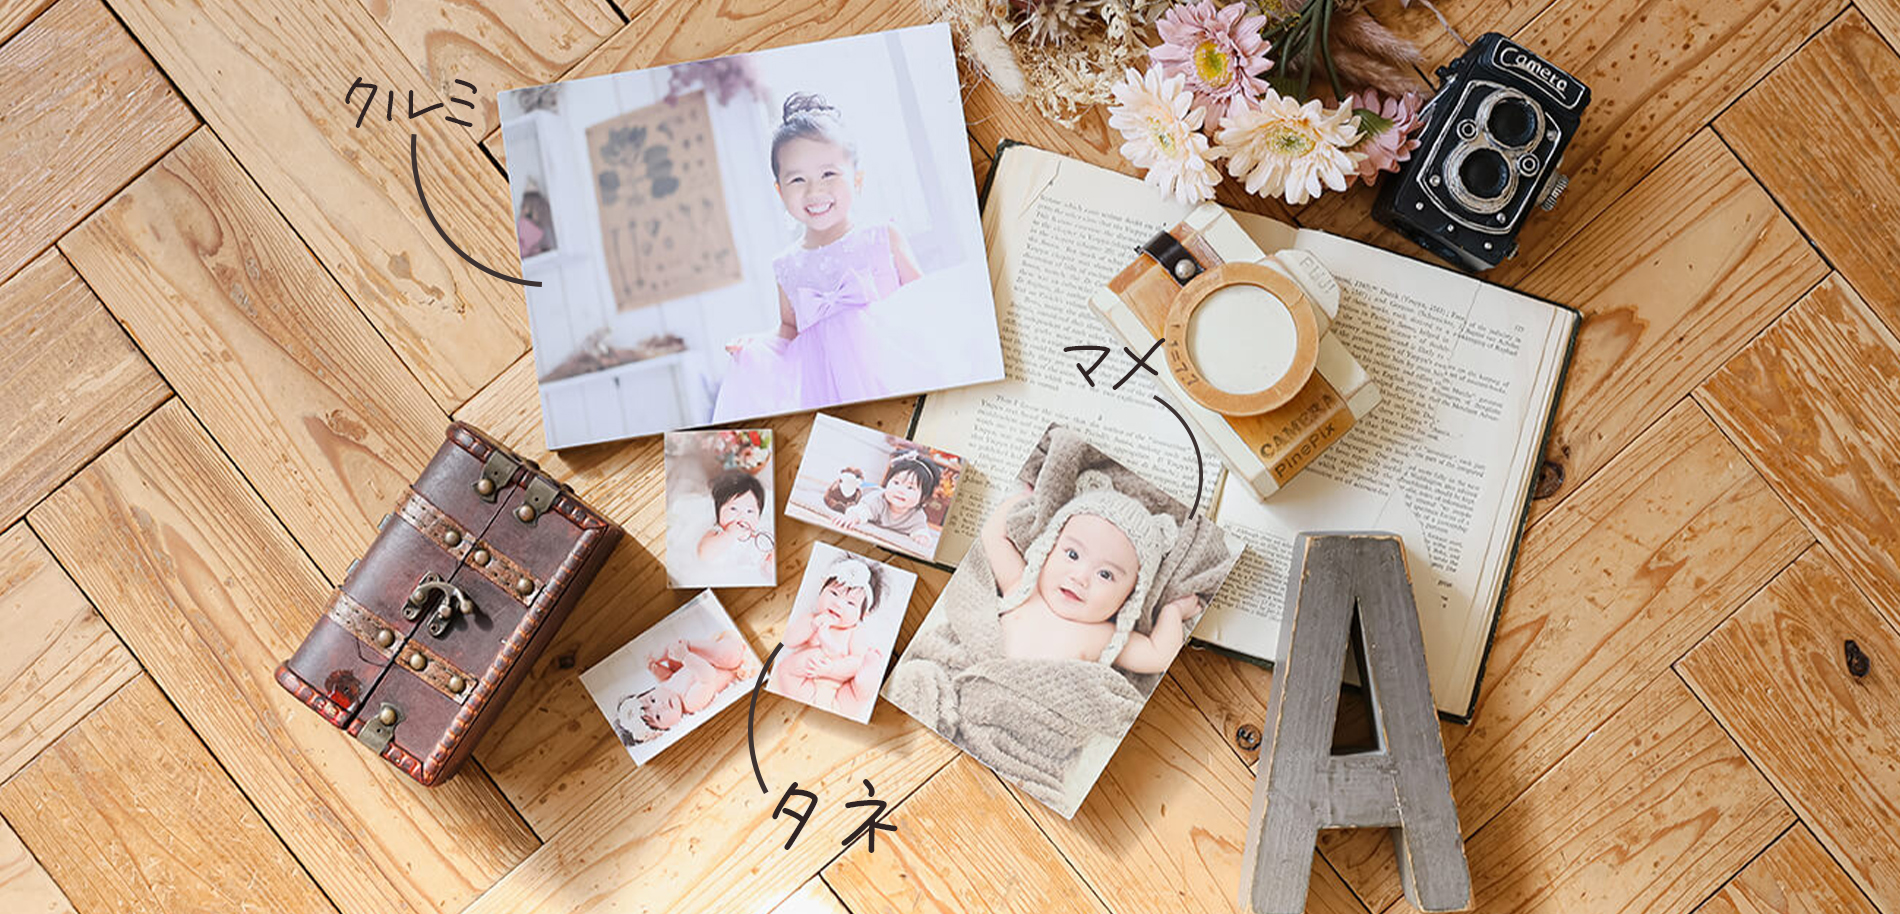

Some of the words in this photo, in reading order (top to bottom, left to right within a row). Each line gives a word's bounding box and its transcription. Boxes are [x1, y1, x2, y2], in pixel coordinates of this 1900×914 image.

[1499, 46, 1569, 93] Camera
[1260, 394, 1332, 459] CAMERA
[1274, 422, 1336, 479] PinePix
[1238, 531, 1475, 914] A
